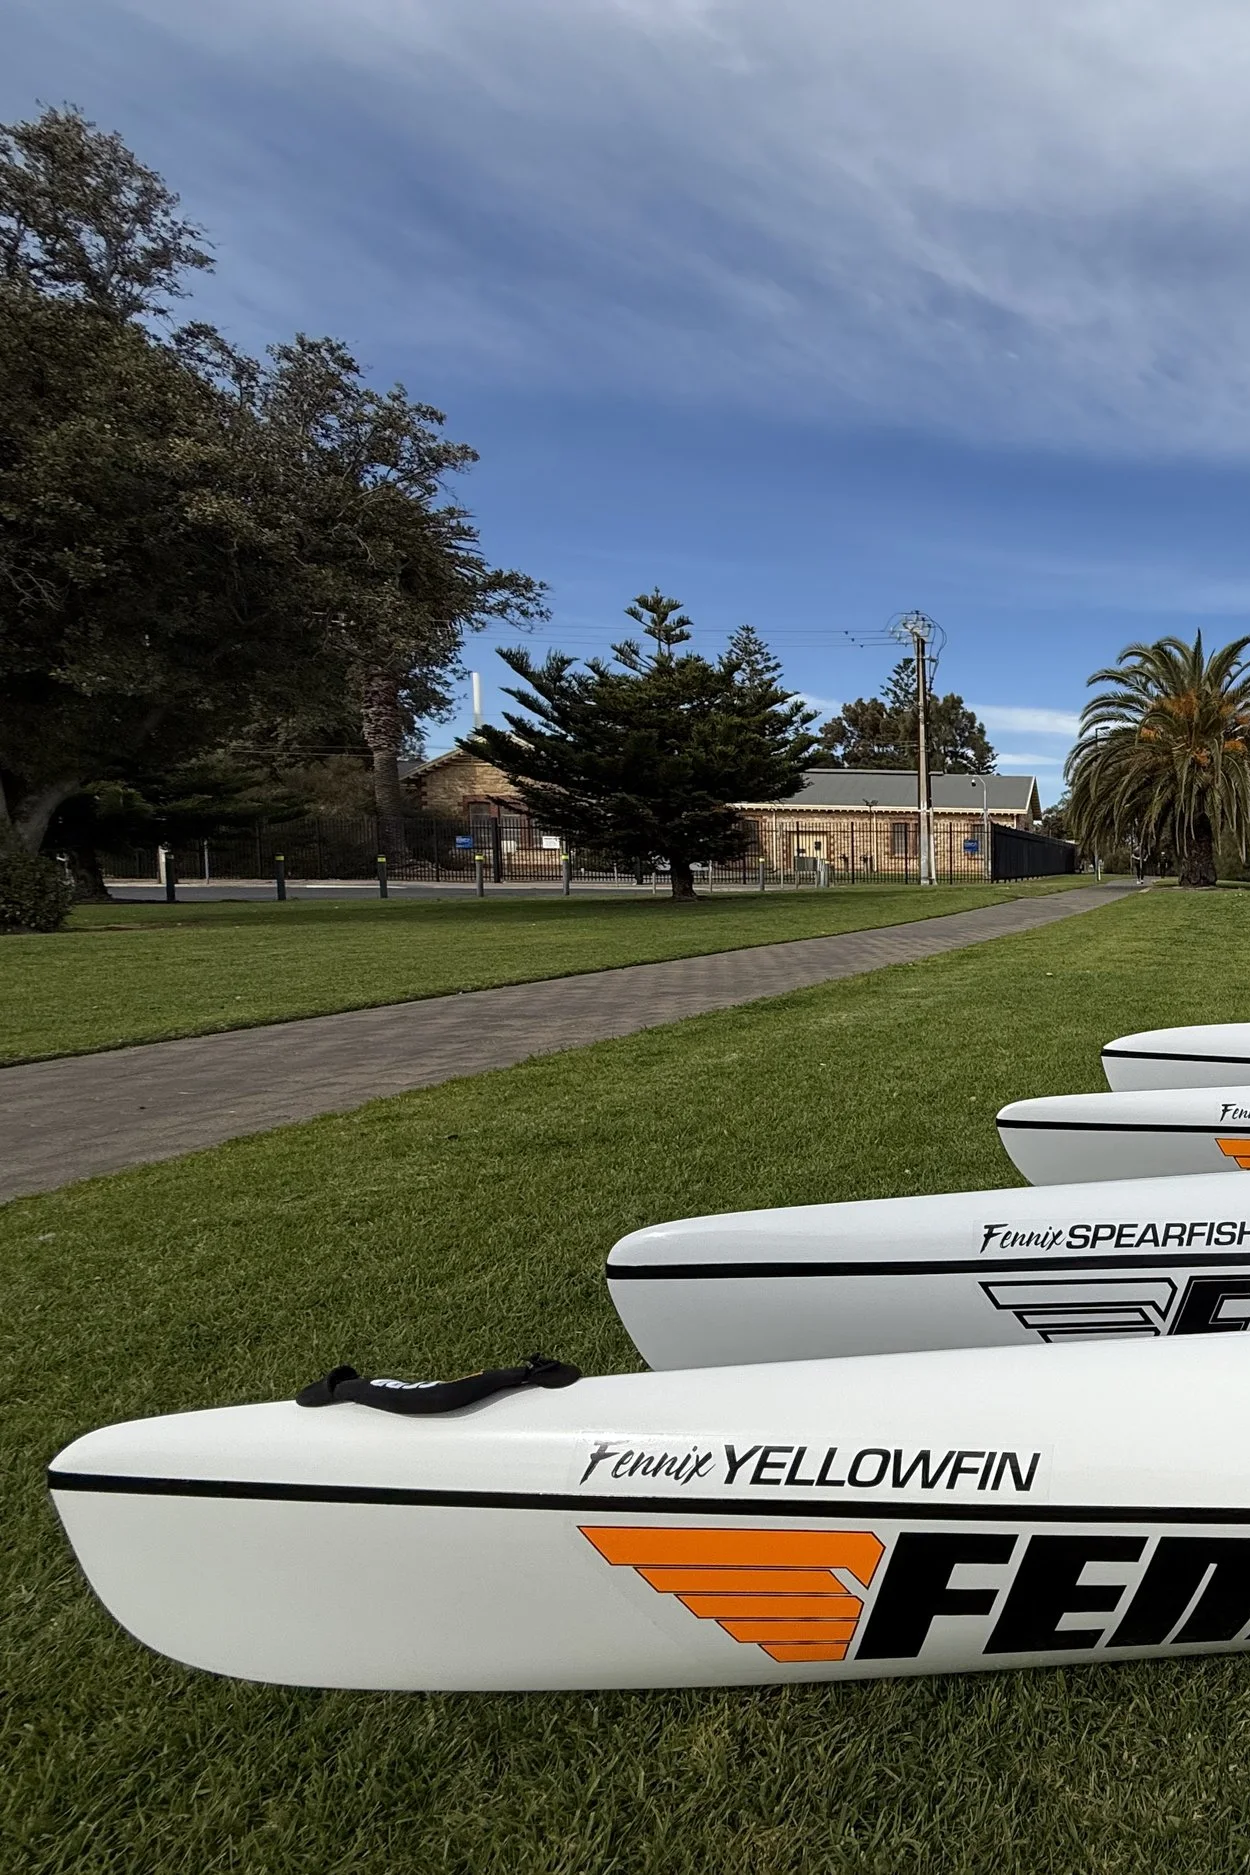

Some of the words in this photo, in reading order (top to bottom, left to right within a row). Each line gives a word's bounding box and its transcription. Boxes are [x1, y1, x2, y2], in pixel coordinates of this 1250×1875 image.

[979, 1223, 1067, 1254] Fennix
[579, 1440, 716, 1484] Fennix
[722, 1443, 1041, 1493] YELLOWFIN
